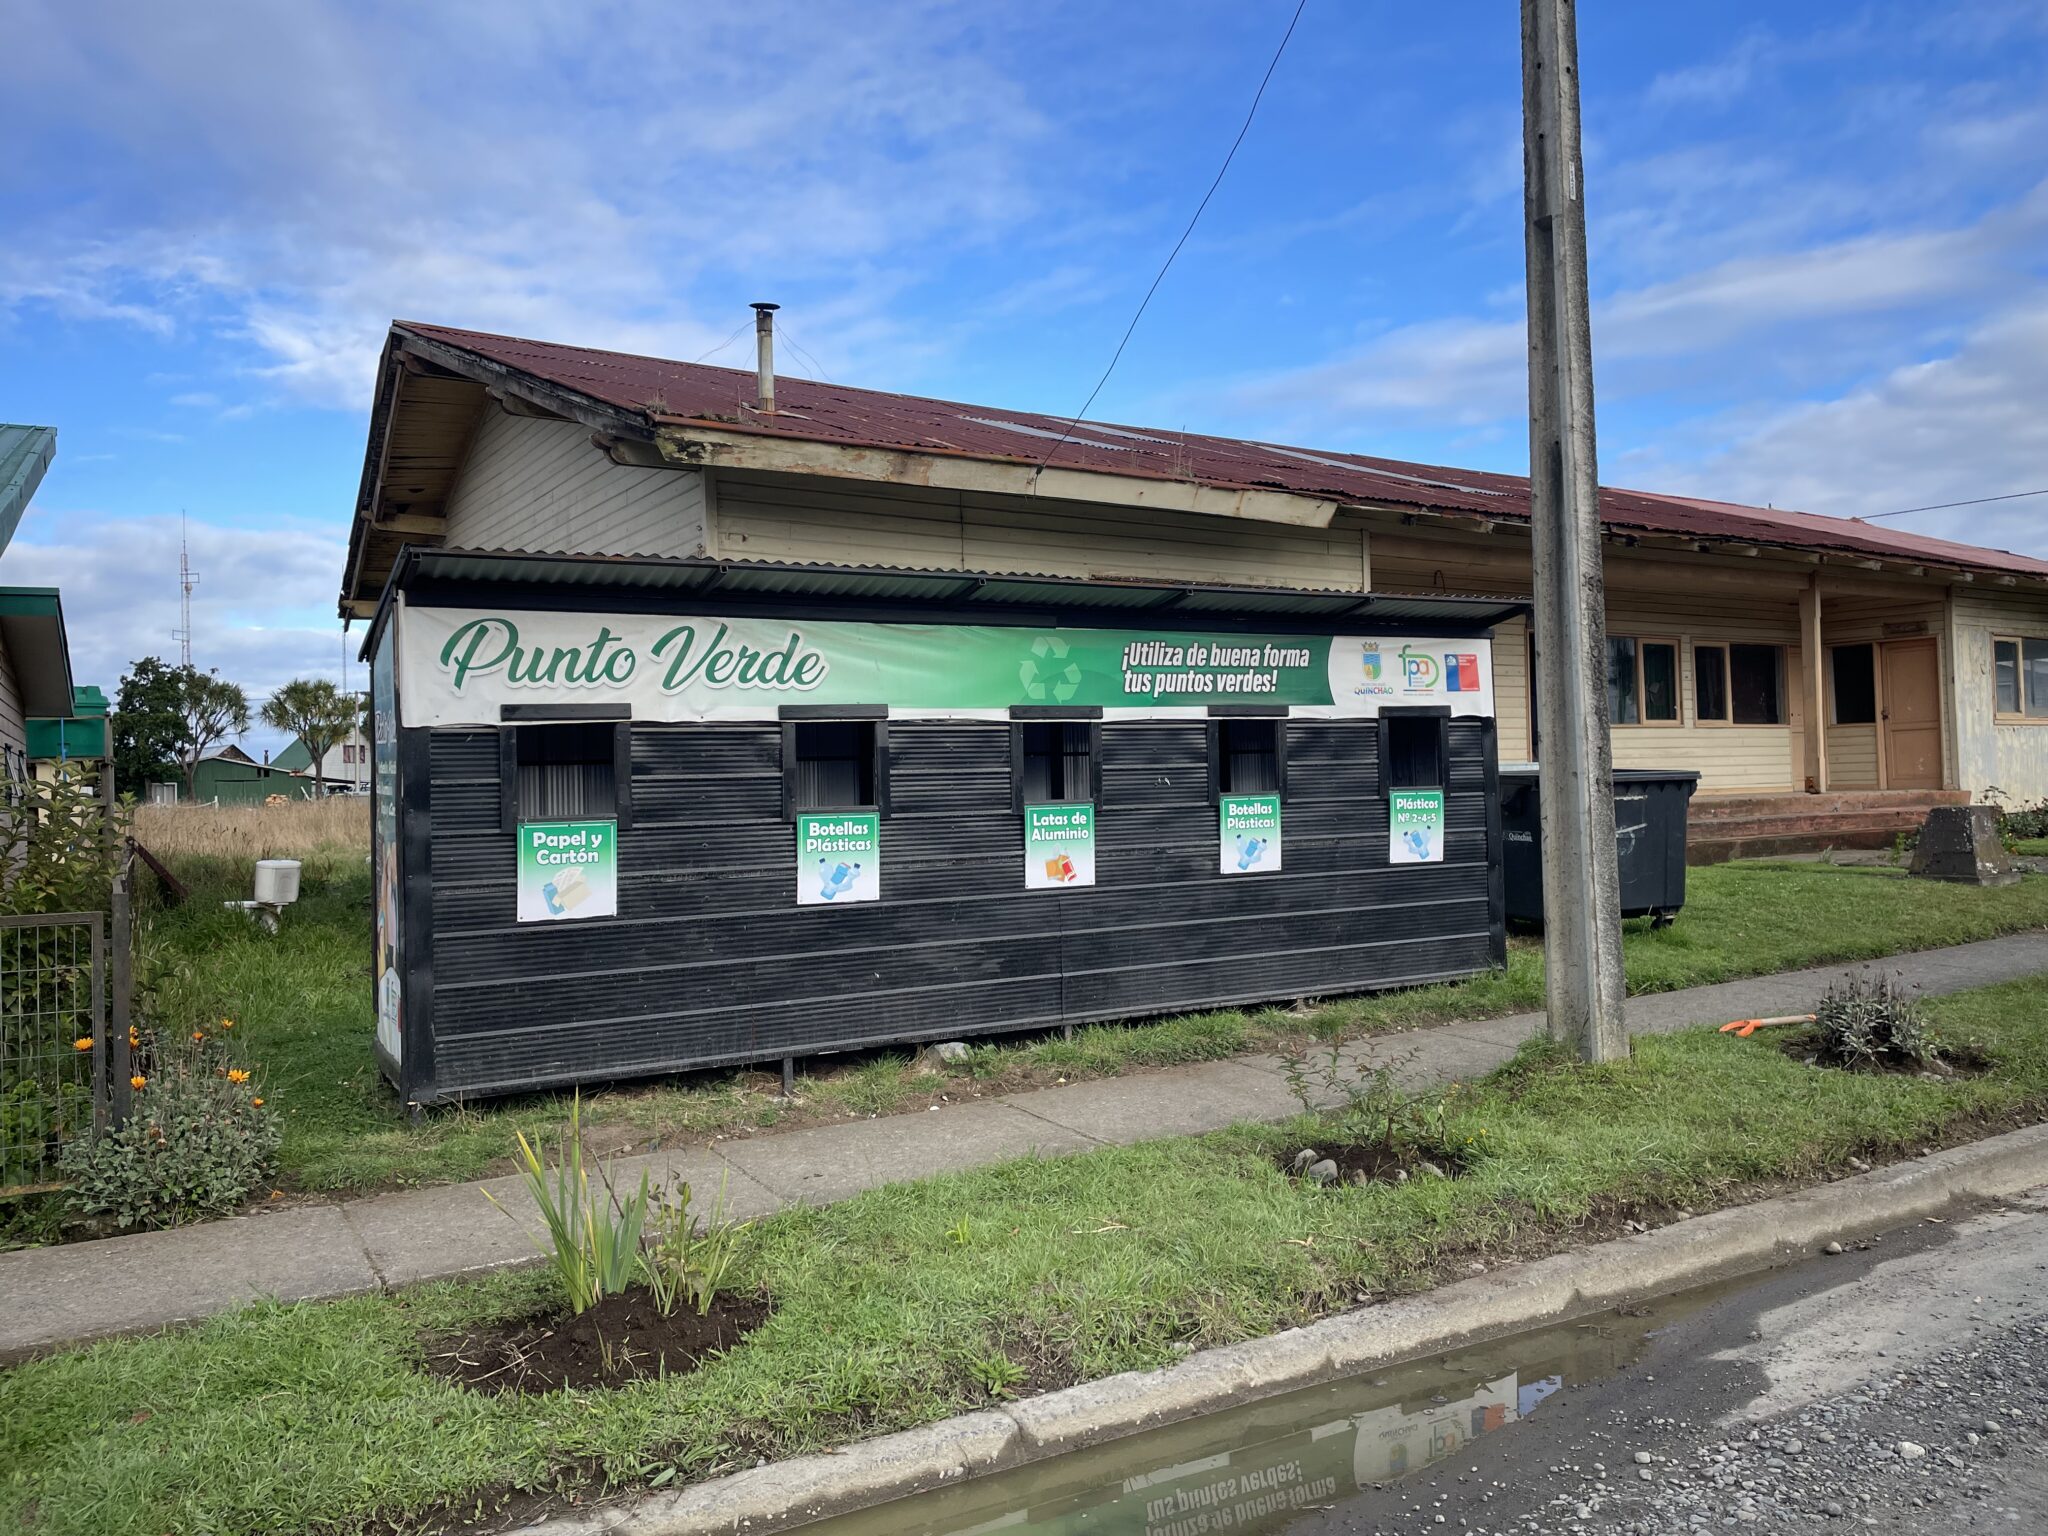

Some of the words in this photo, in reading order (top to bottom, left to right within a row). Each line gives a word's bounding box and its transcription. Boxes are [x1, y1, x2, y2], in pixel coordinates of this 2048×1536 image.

[438, 616, 637, 691] Punto
[650, 621, 826, 692] Verde
[1121, 641, 1183, 671] ¡Utiliza
[1186, 641, 1207, 667] de
[1209, 642, 1260, 668] buena
[1262, 643, 1310, 668] forma
[1123, 670, 1152, 693] tus
[1153, 670, 1214, 698] puntos
[1216, 668, 1278, 693] verdes!
[1228, 802, 1273, 816] Botellas
[1396, 798, 1439, 810] Plásticos
[1033, 813, 1068, 826] Latas
[1071, 811, 1087, 825] de
[1227, 817, 1275, 830] Plásticas
[1412, 813, 1437, 823] 2-4-5
[809, 821, 869, 837] Botellas
[1031, 827, 1089, 841] Aluminio
[532, 830, 587, 850] Papel
[590, 834, 603, 848] y
[806, 838, 872, 853] Plásticas
[536, 847, 599, 865] Cartón
